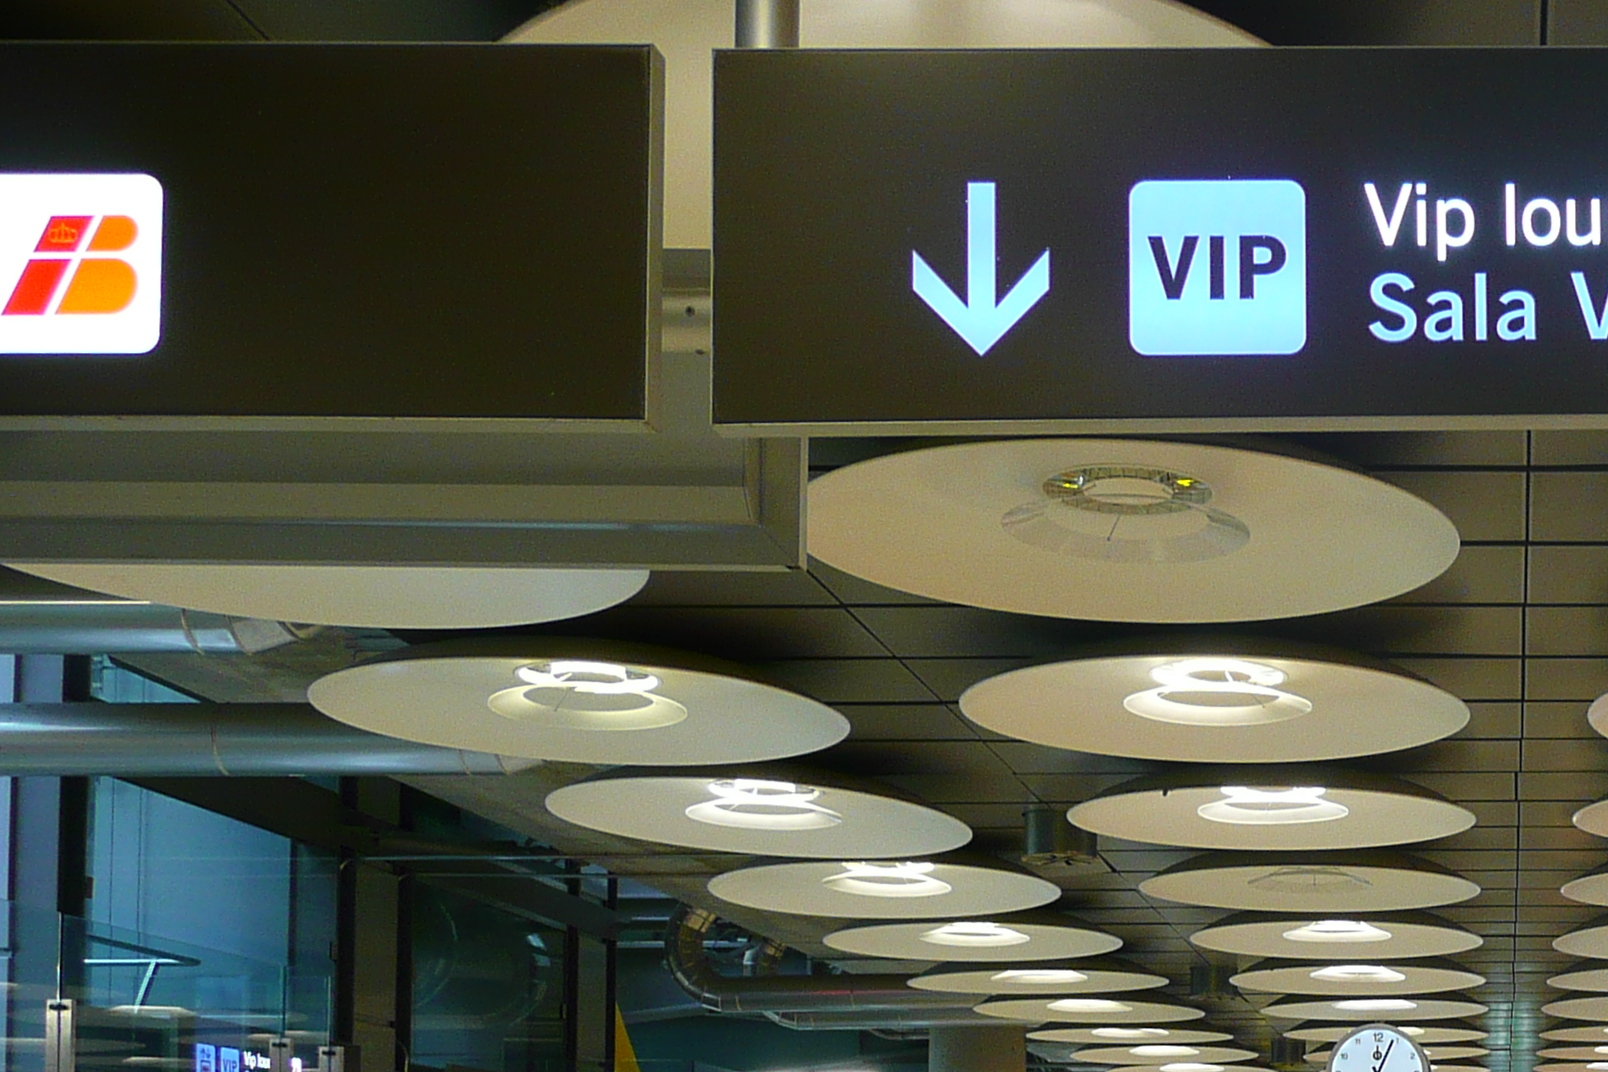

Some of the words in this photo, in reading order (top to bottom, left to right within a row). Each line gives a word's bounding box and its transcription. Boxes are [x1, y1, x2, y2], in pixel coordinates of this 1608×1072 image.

[1365, 182, 1475, 260] Vip
[1147, 235, 1288, 300] VIP
[1368, 272, 1537, 343] Sala
